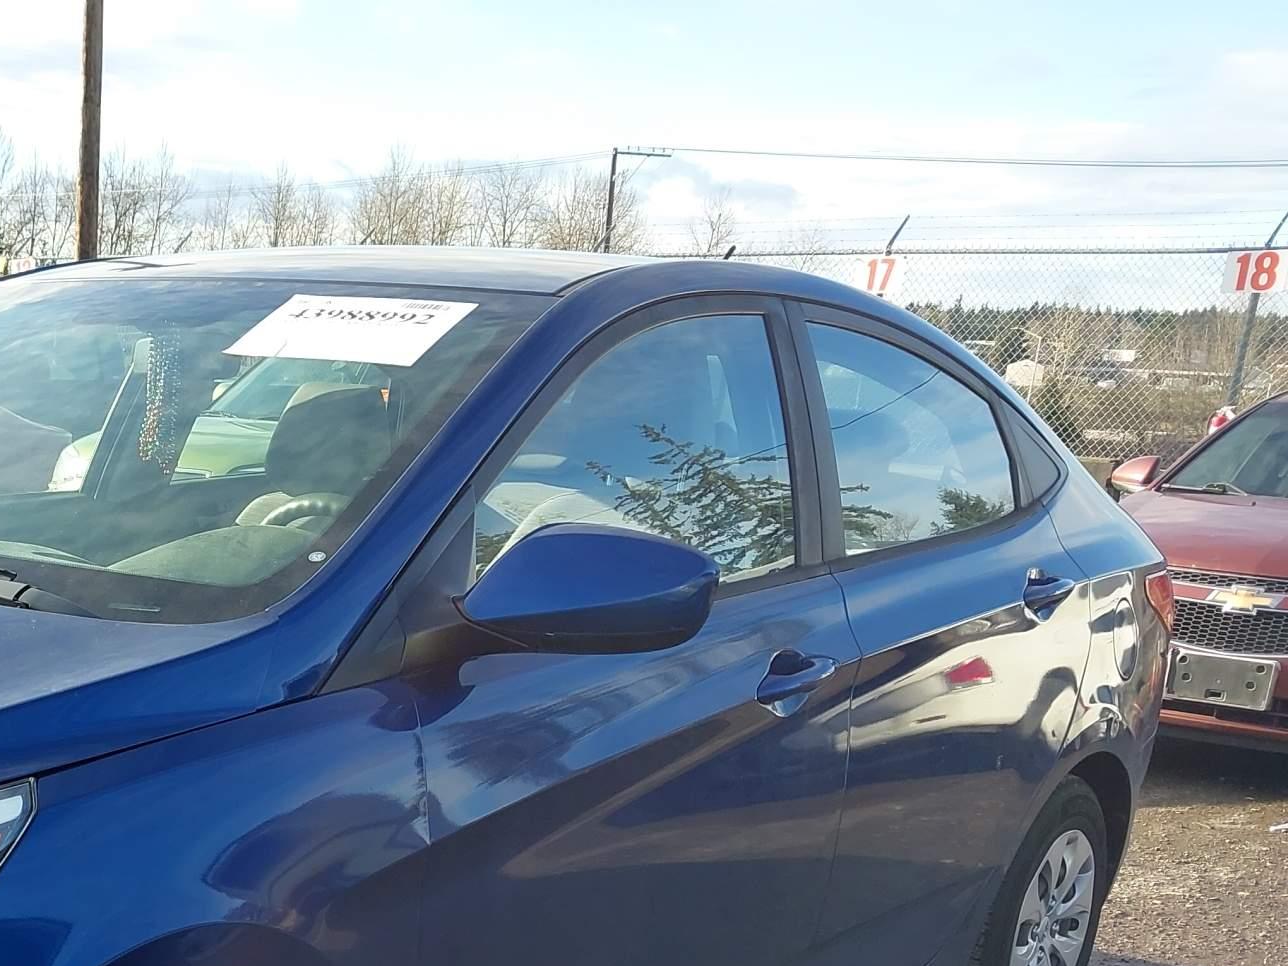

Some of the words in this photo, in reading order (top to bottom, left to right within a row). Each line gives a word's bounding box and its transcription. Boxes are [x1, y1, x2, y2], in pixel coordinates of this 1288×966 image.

[866, 258, 894, 291] 17
[1235, 251, 1280, 291] 18
[288, 308, 436, 325] 43988992
